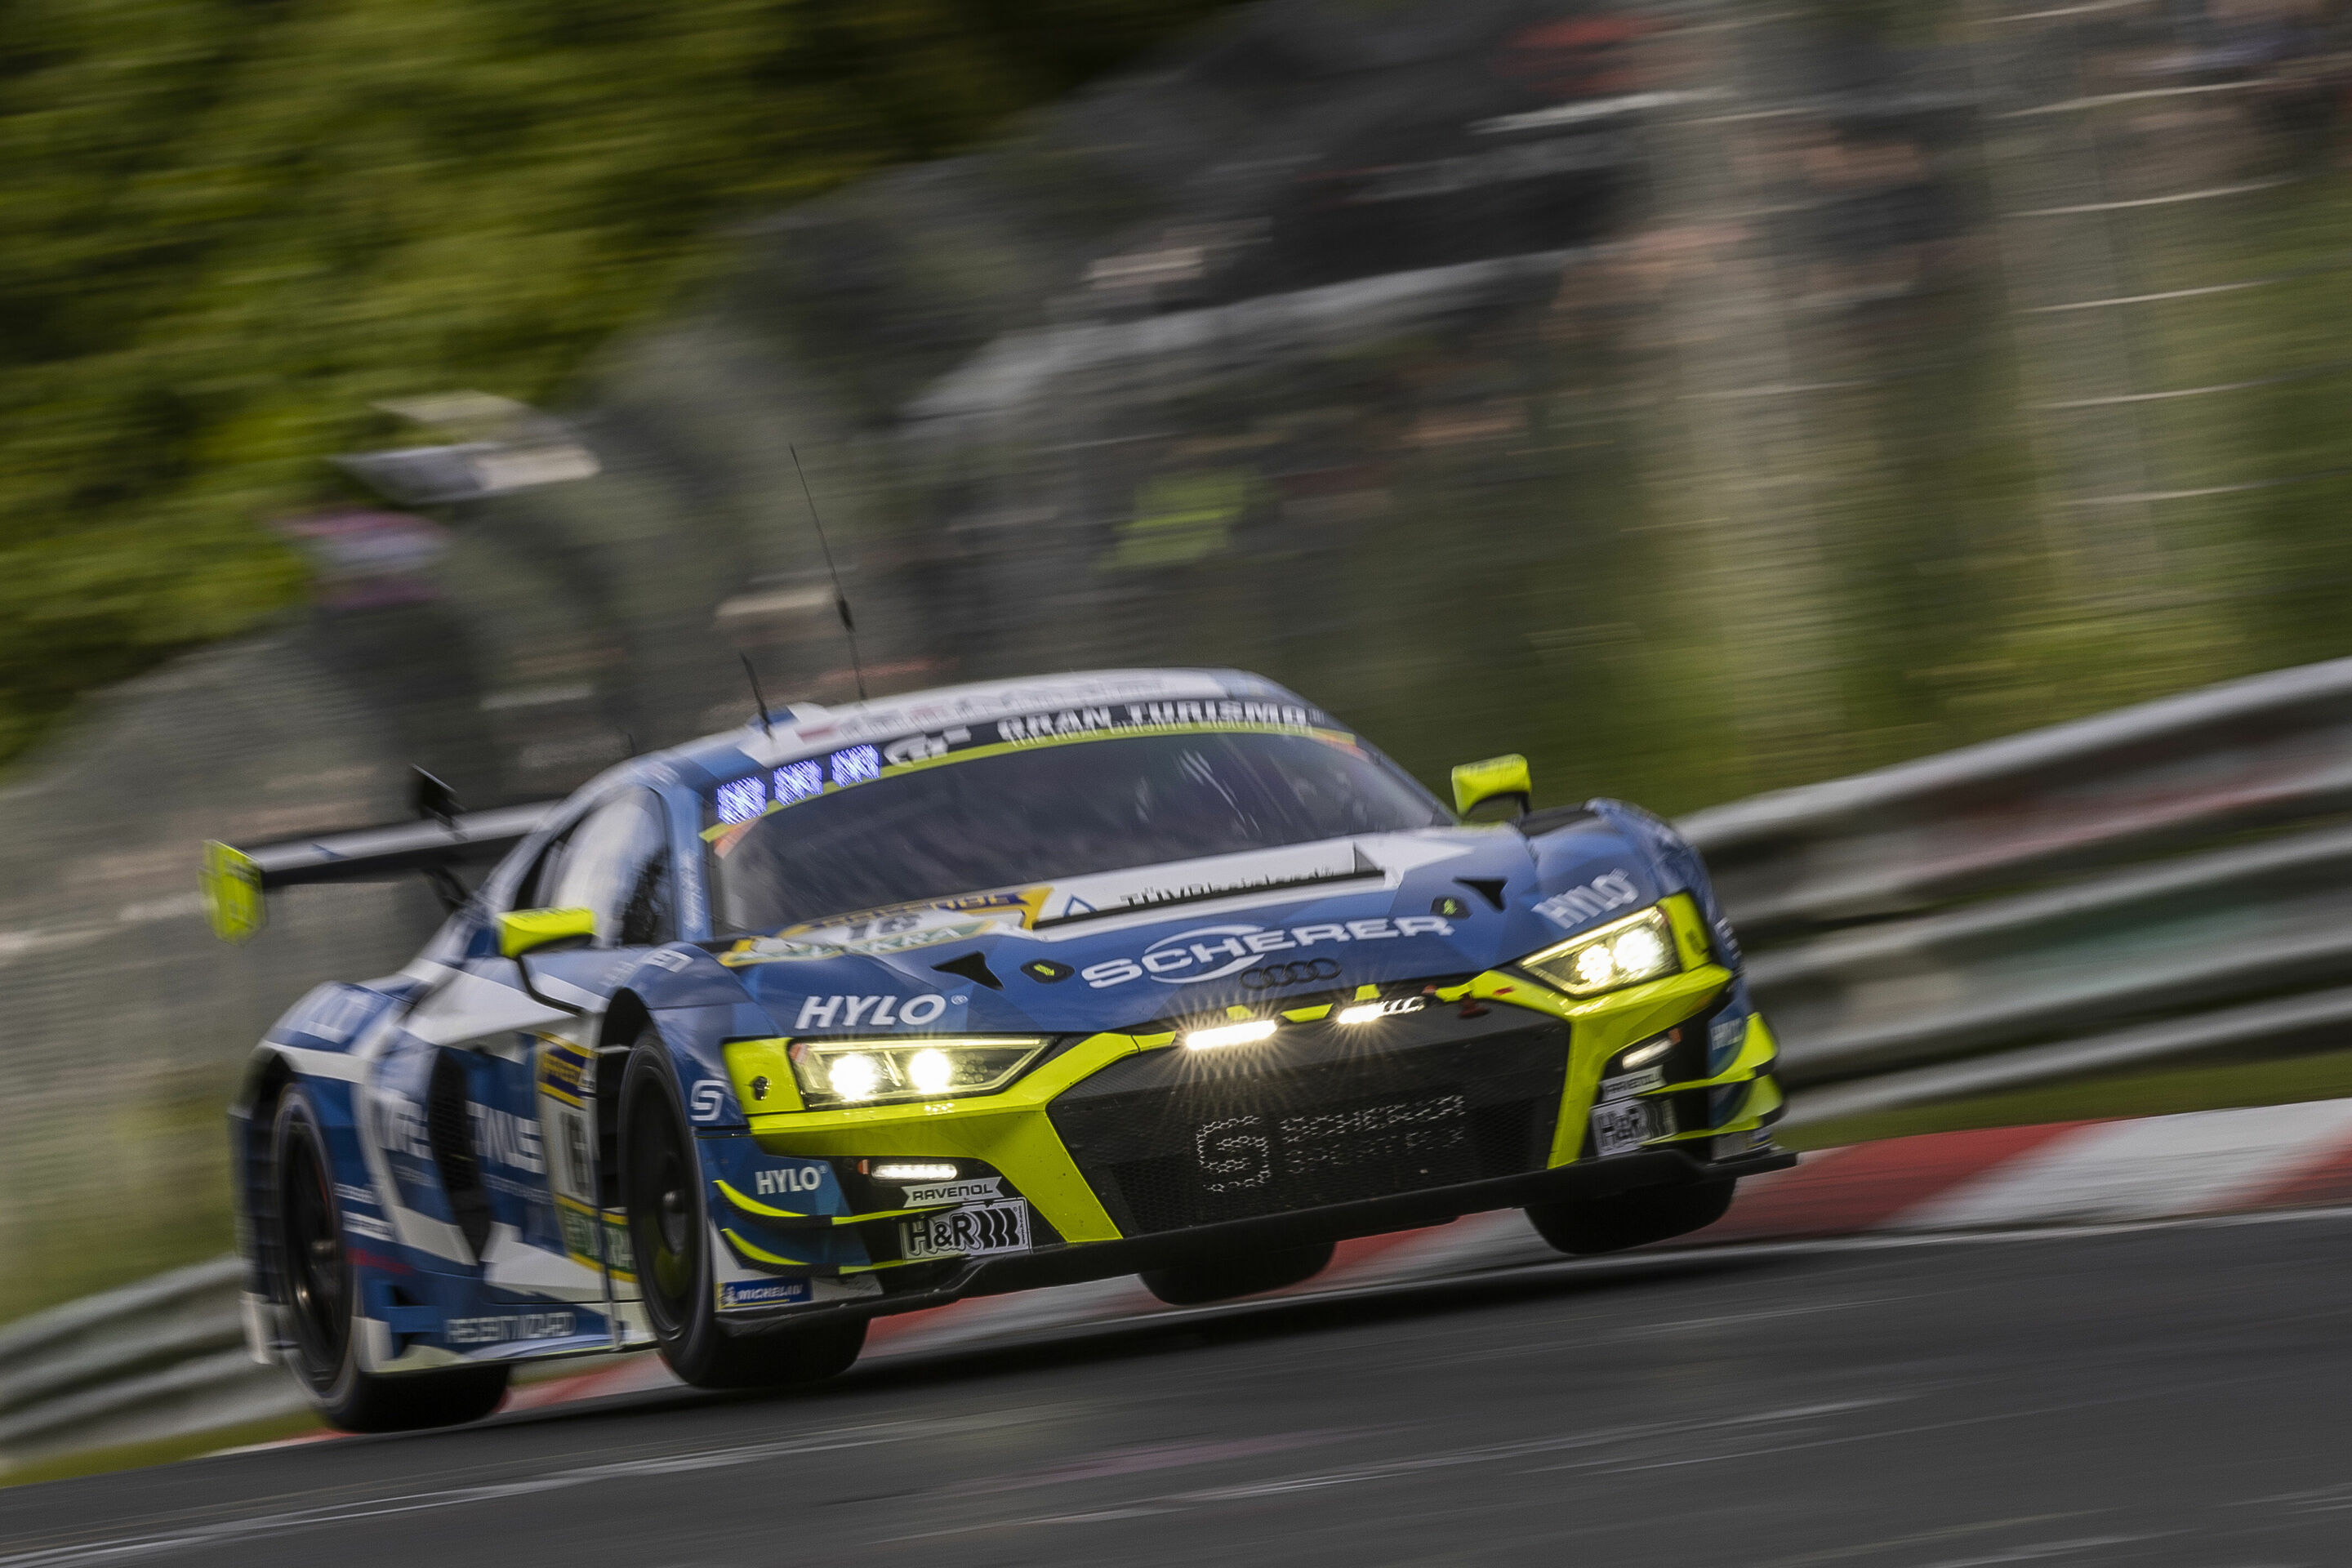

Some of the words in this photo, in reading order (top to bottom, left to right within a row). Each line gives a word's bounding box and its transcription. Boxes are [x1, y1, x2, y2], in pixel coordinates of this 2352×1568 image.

[1080, 915, 1455, 989] SCHERER
[912, 1183, 994, 1201] RAVENOL
[907, 1214, 977, 1252] H&R
